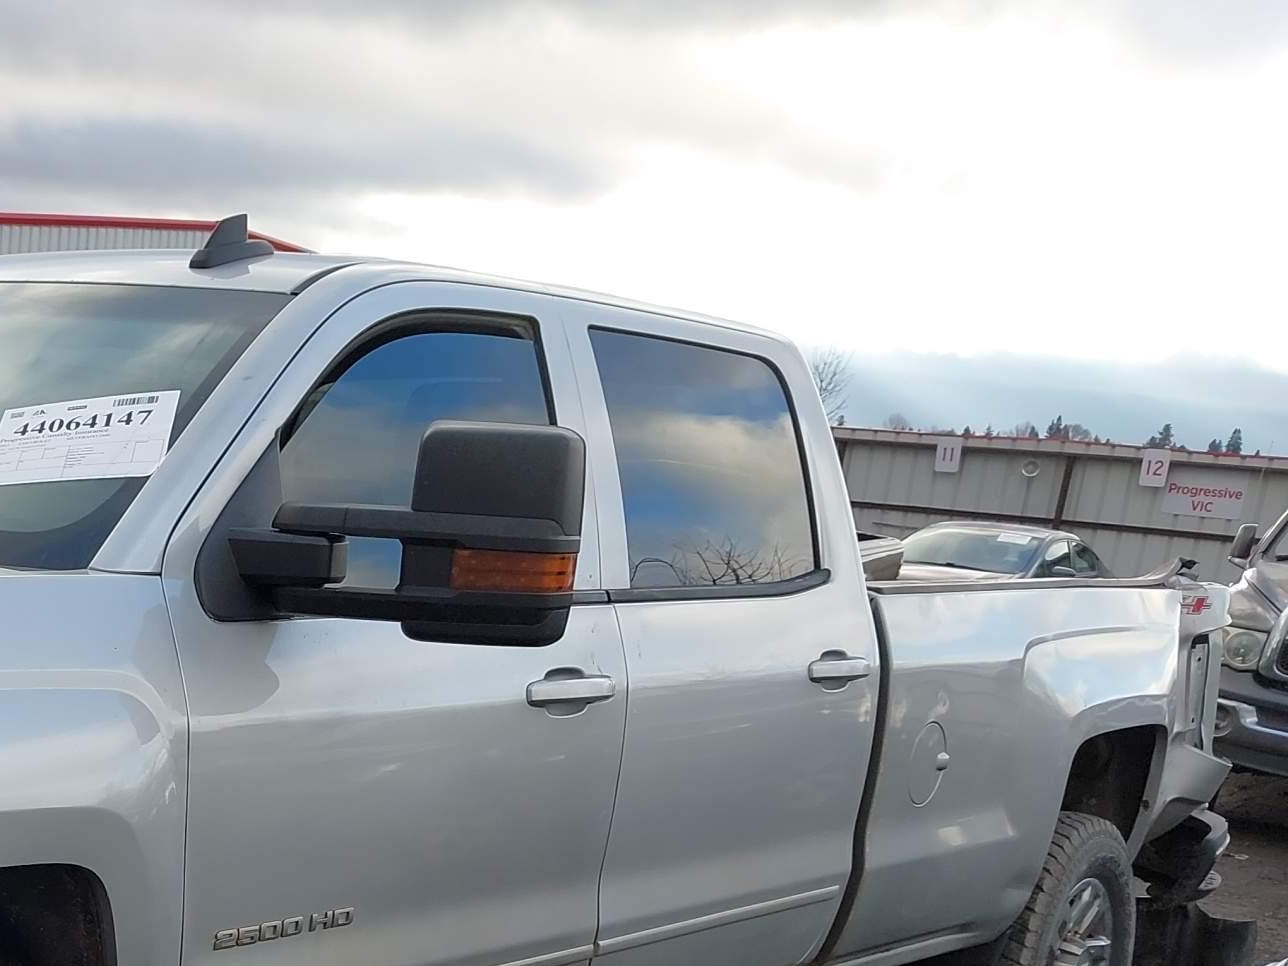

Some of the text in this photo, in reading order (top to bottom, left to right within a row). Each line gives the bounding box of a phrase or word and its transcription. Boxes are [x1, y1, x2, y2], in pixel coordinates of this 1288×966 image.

[13, 409, 154, 438] 44064147
[942, 447, 954, 462] 11
[1145, 460, 1164, 477] 12
[1168, 483, 1244, 500] Progressive
[1191, 500, 1215, 513] VIC
[212, 906, 355, 952] 2500 HD
